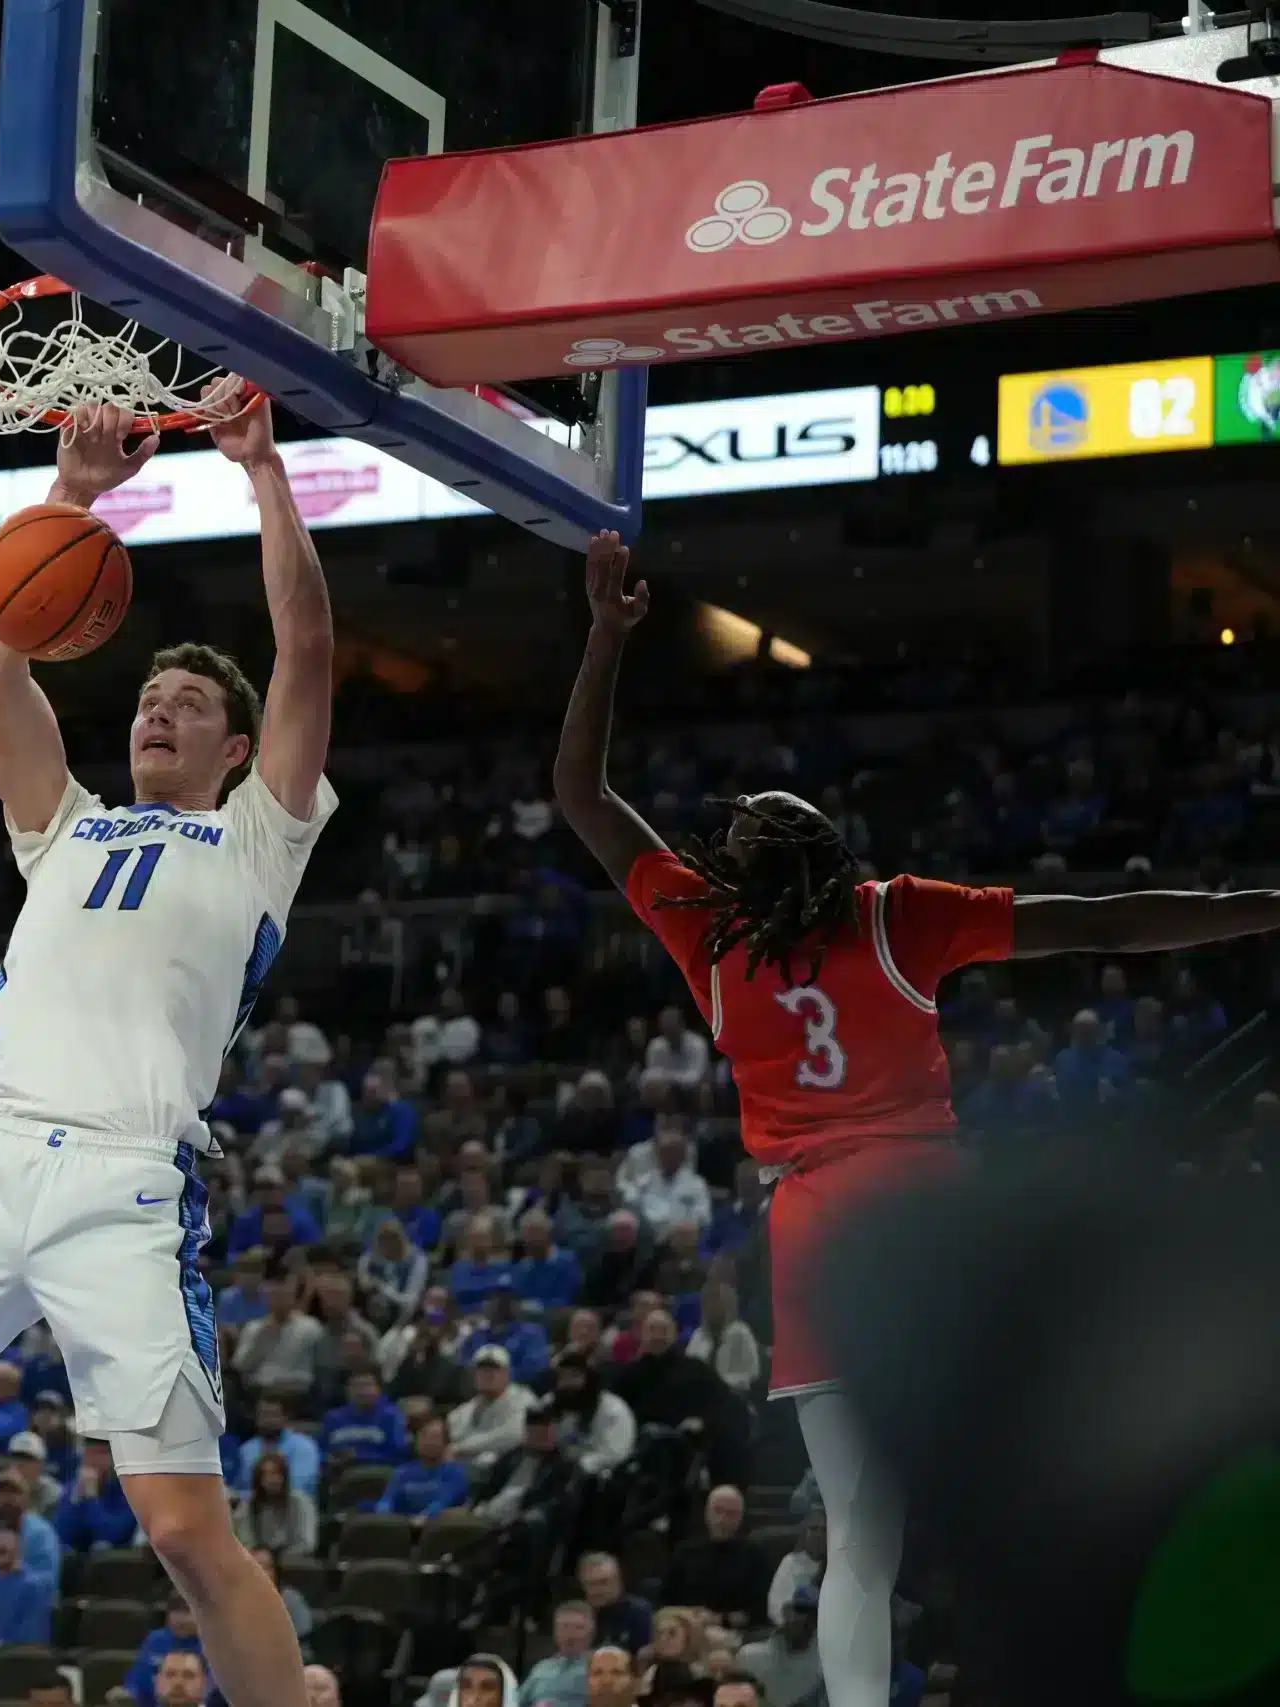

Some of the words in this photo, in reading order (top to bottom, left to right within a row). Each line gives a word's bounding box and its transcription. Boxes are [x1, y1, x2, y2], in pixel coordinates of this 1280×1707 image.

[644, 417, 856, 471] EXUS
[82, 842, 167, 910] 11
[774, 985, 848, 1089] 3
[47, 1128, 67, 1148] C
